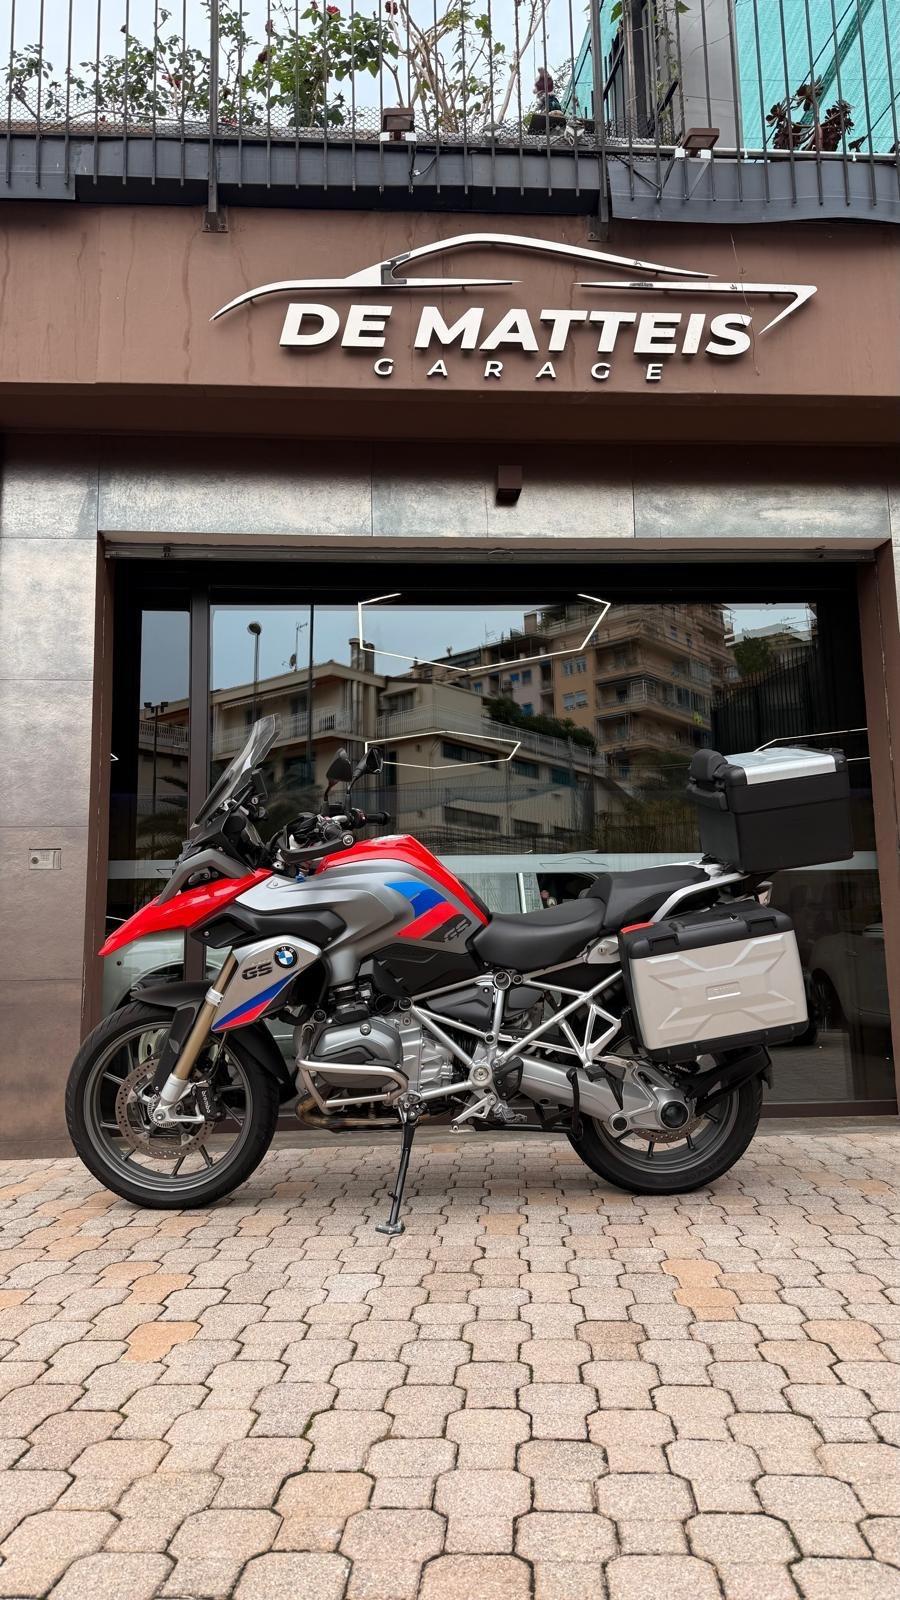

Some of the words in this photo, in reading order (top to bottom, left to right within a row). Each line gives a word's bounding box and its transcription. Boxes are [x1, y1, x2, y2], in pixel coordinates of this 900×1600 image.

[279, 303, 393, 348] DE
[414, 306, 753, 357] MATTEIS
[373, 358, 664, 381] GARAGE
[241, 961, 273, 980] GS
[201, 1090, 211, 1114] brembo
